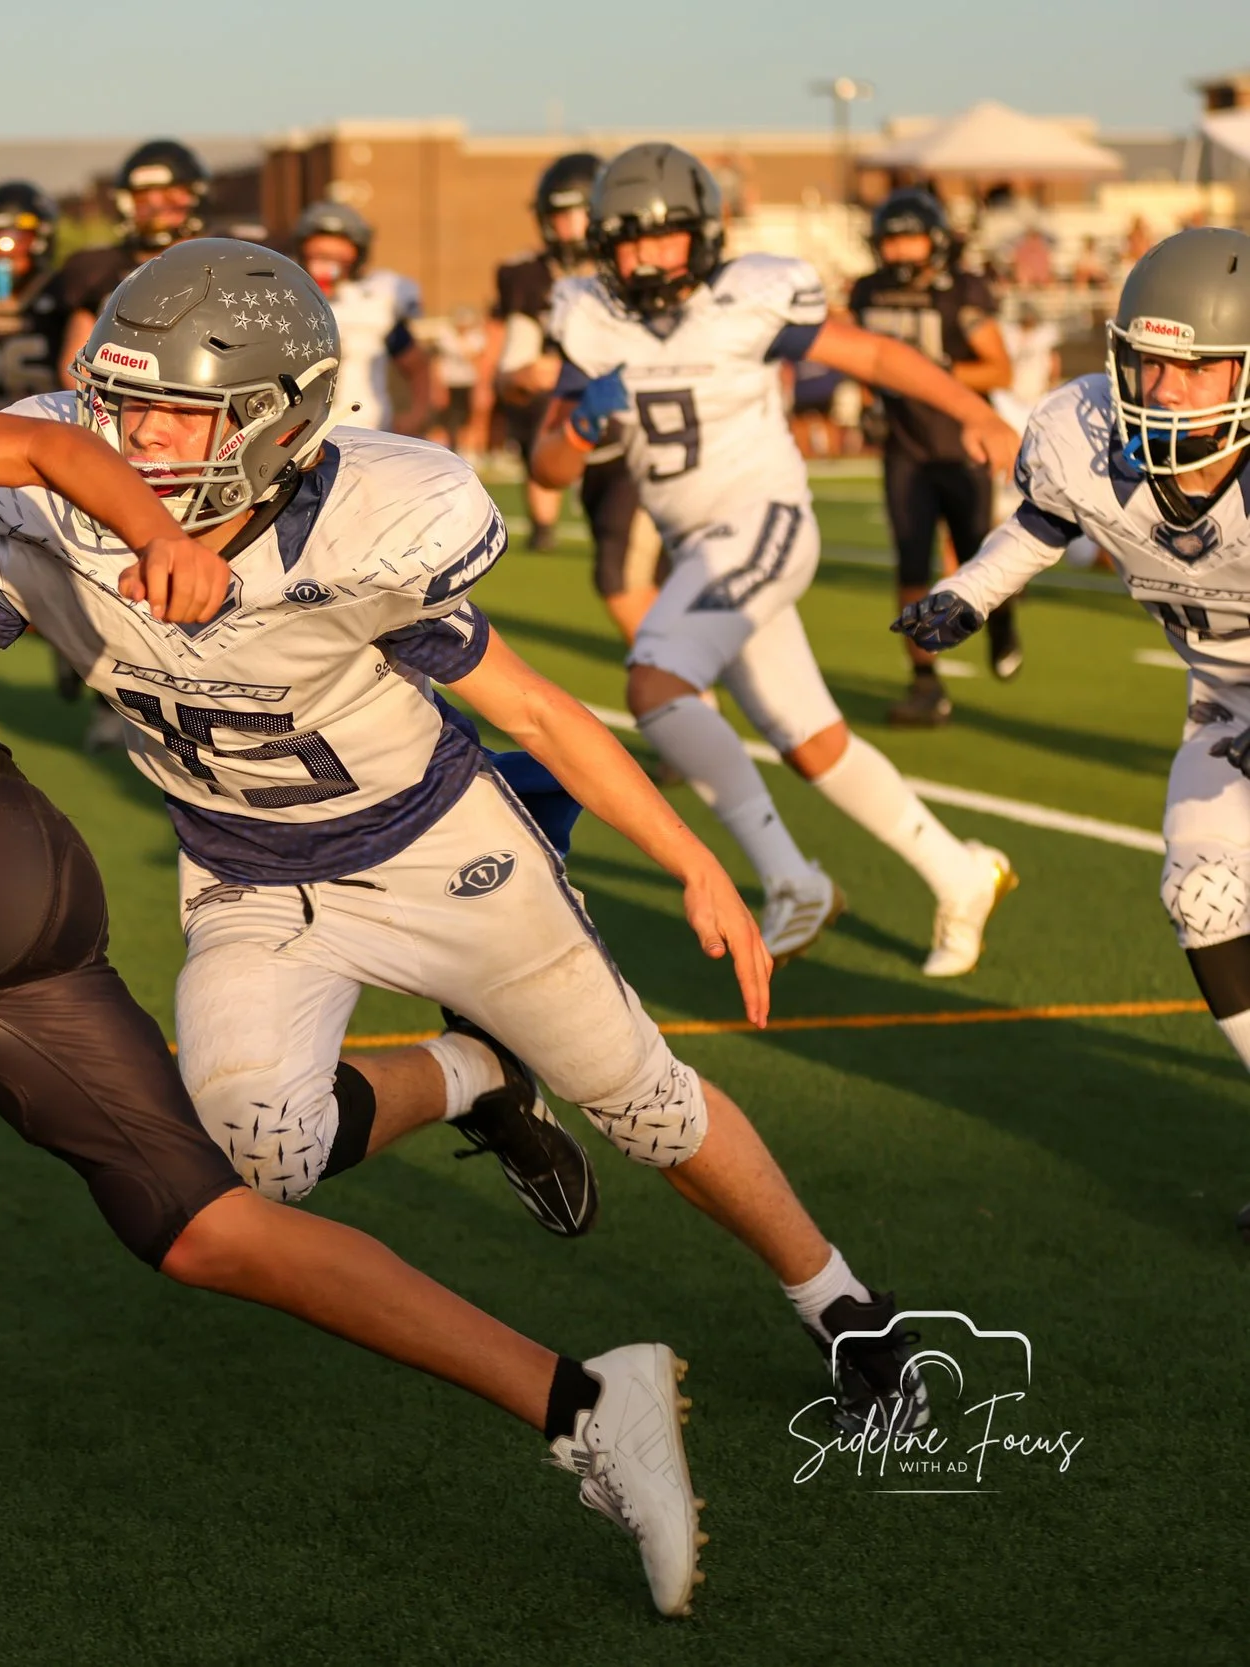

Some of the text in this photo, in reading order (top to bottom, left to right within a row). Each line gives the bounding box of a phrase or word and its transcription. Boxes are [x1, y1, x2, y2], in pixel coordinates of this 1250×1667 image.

[1145, 320, 1180, 337] Riddell
[100, 348, 149, 371] Riddell
[635, 388, 700, 484] 9
[116, 688, 360, 809] 15
